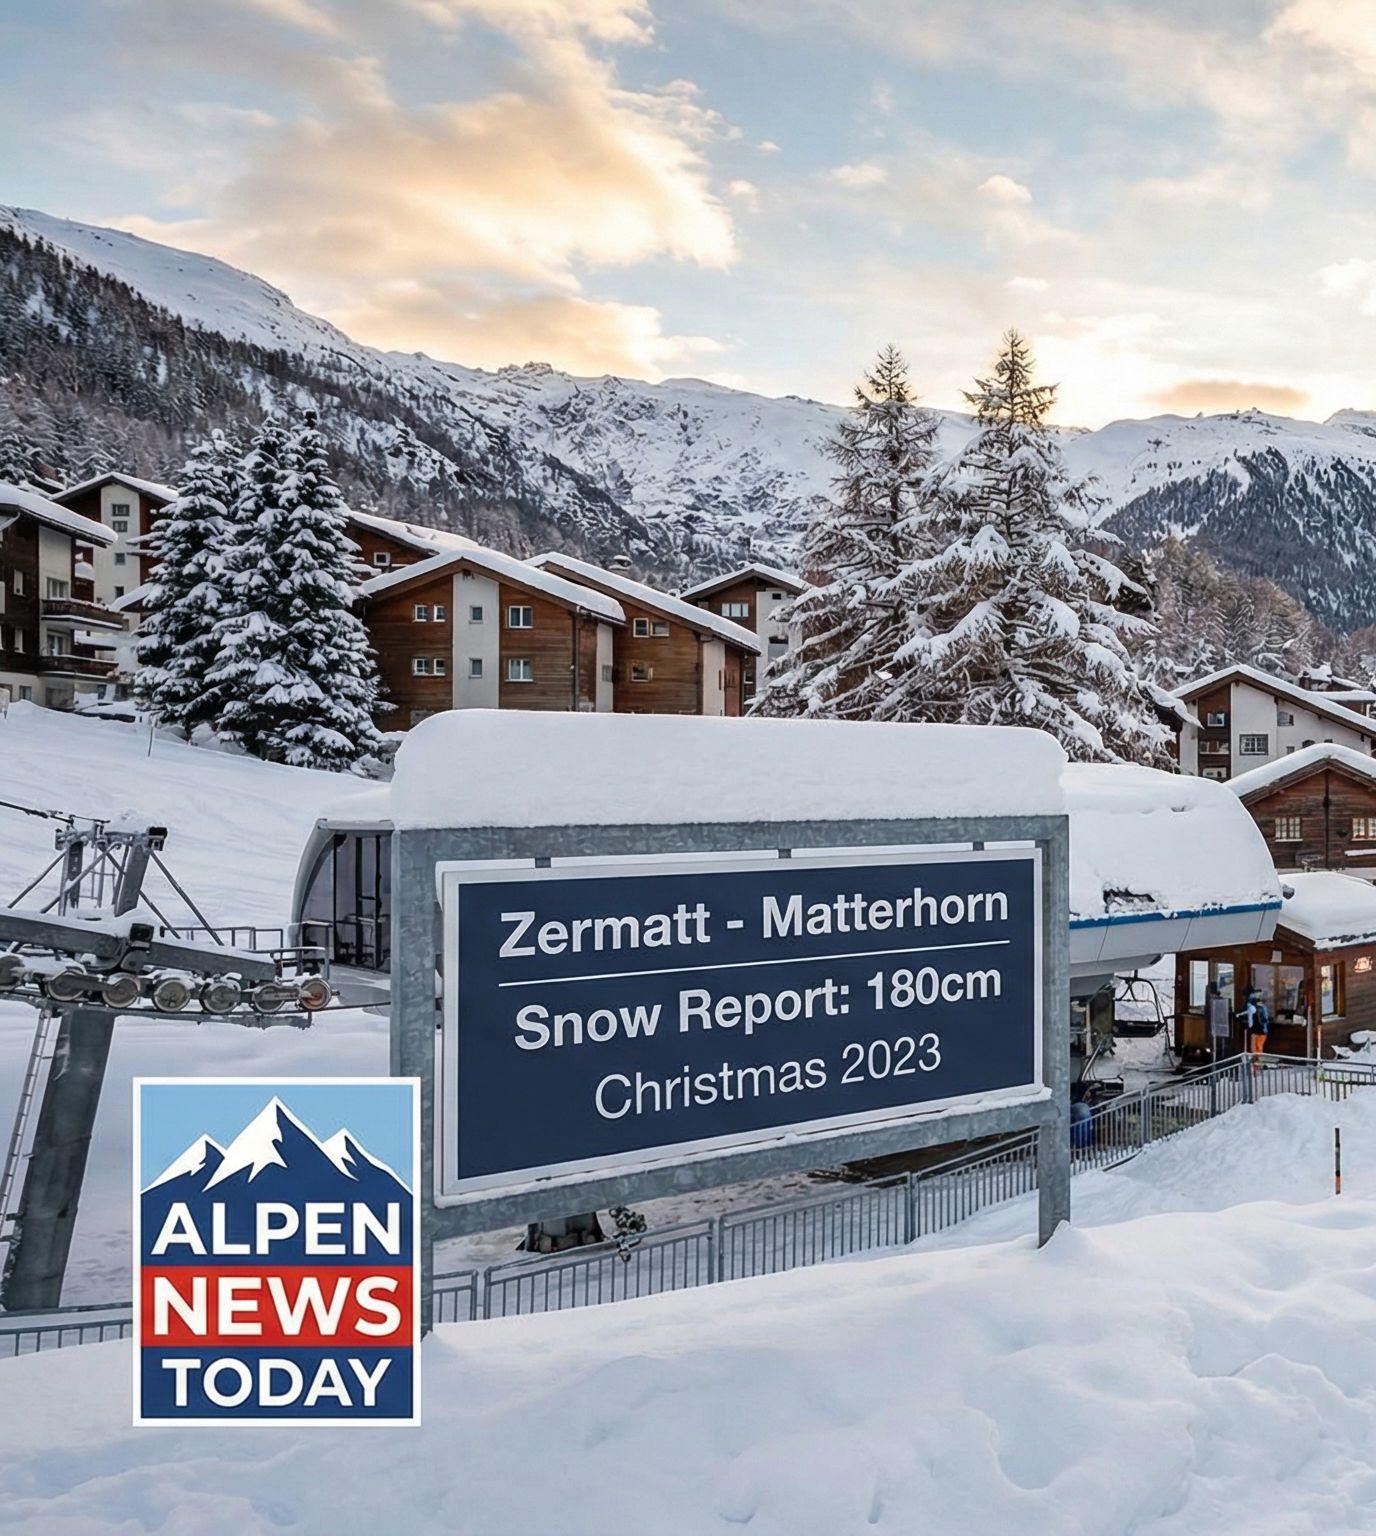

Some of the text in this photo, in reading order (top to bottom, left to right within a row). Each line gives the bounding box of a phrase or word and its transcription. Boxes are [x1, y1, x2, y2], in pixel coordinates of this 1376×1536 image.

[498, 887, 1009, 959] Zermatt - Matterhorn
[514, 966, 1002, 1051] Snow Report: 180cm
[594, 1033, 942, 1120] Christmas 2023
